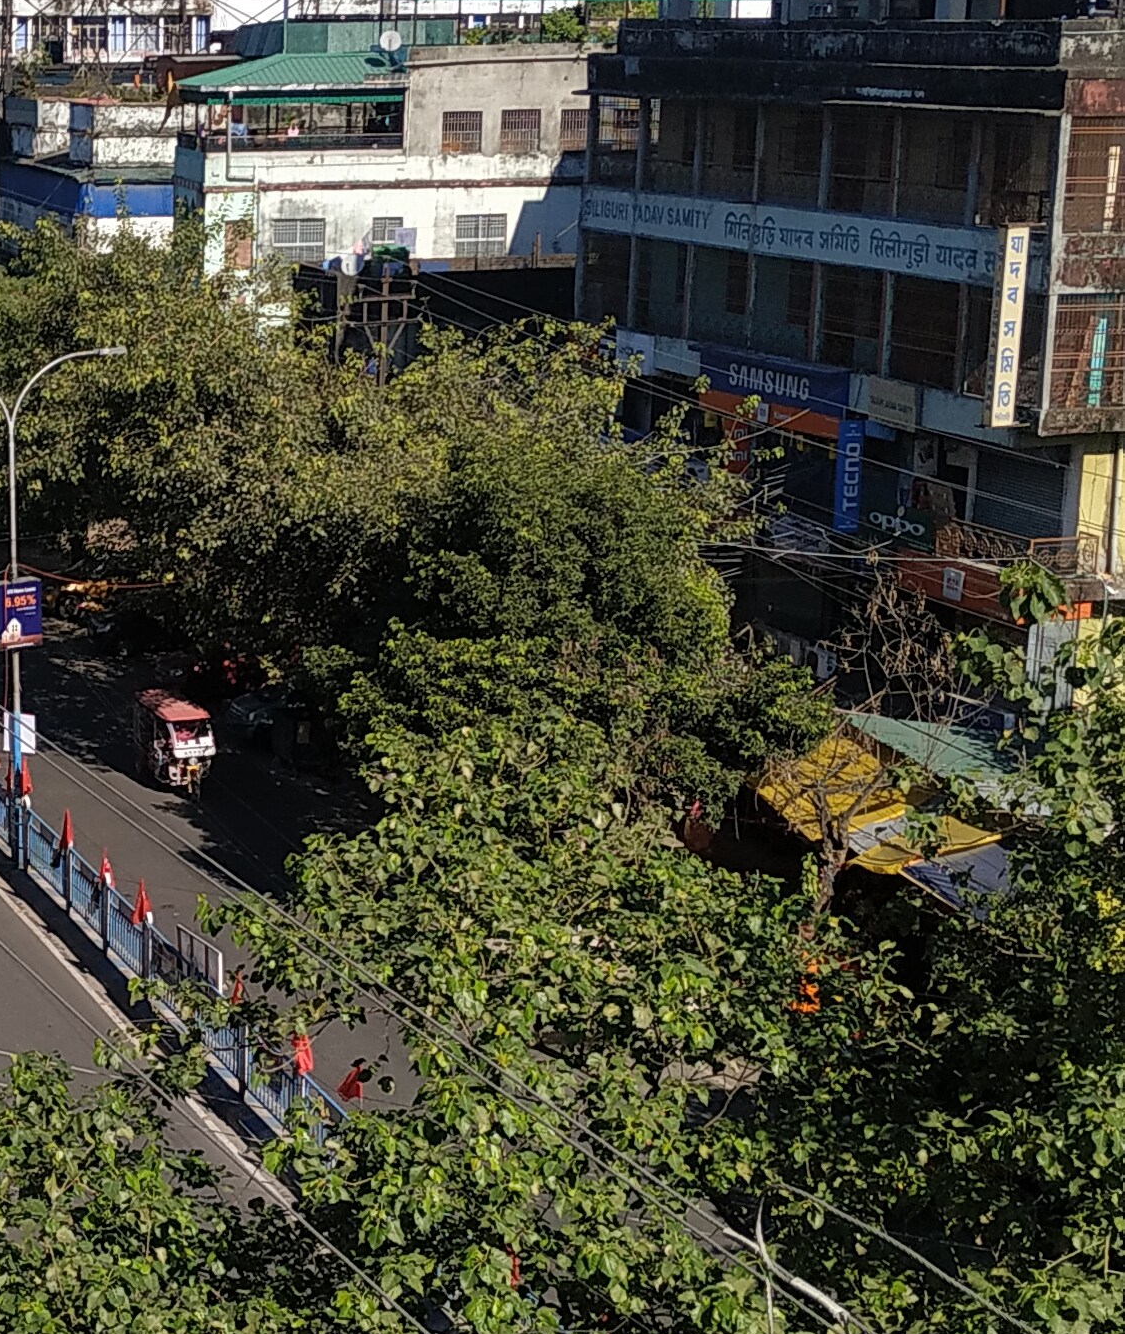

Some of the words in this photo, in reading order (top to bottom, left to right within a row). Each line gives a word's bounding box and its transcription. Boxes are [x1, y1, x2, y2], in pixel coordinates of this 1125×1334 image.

[584, 199, 629, 218] SILIGURI
[632, 204, 665, 225] YADAV
[667, 207, 711, 230] SAMITY
[779, 227, 814, 250] যাদব
[819, 223, 860, 254] সমিতি
[935, 244, 979, 271] यादव
[729, 363, 810, 401] SAMSUNG
